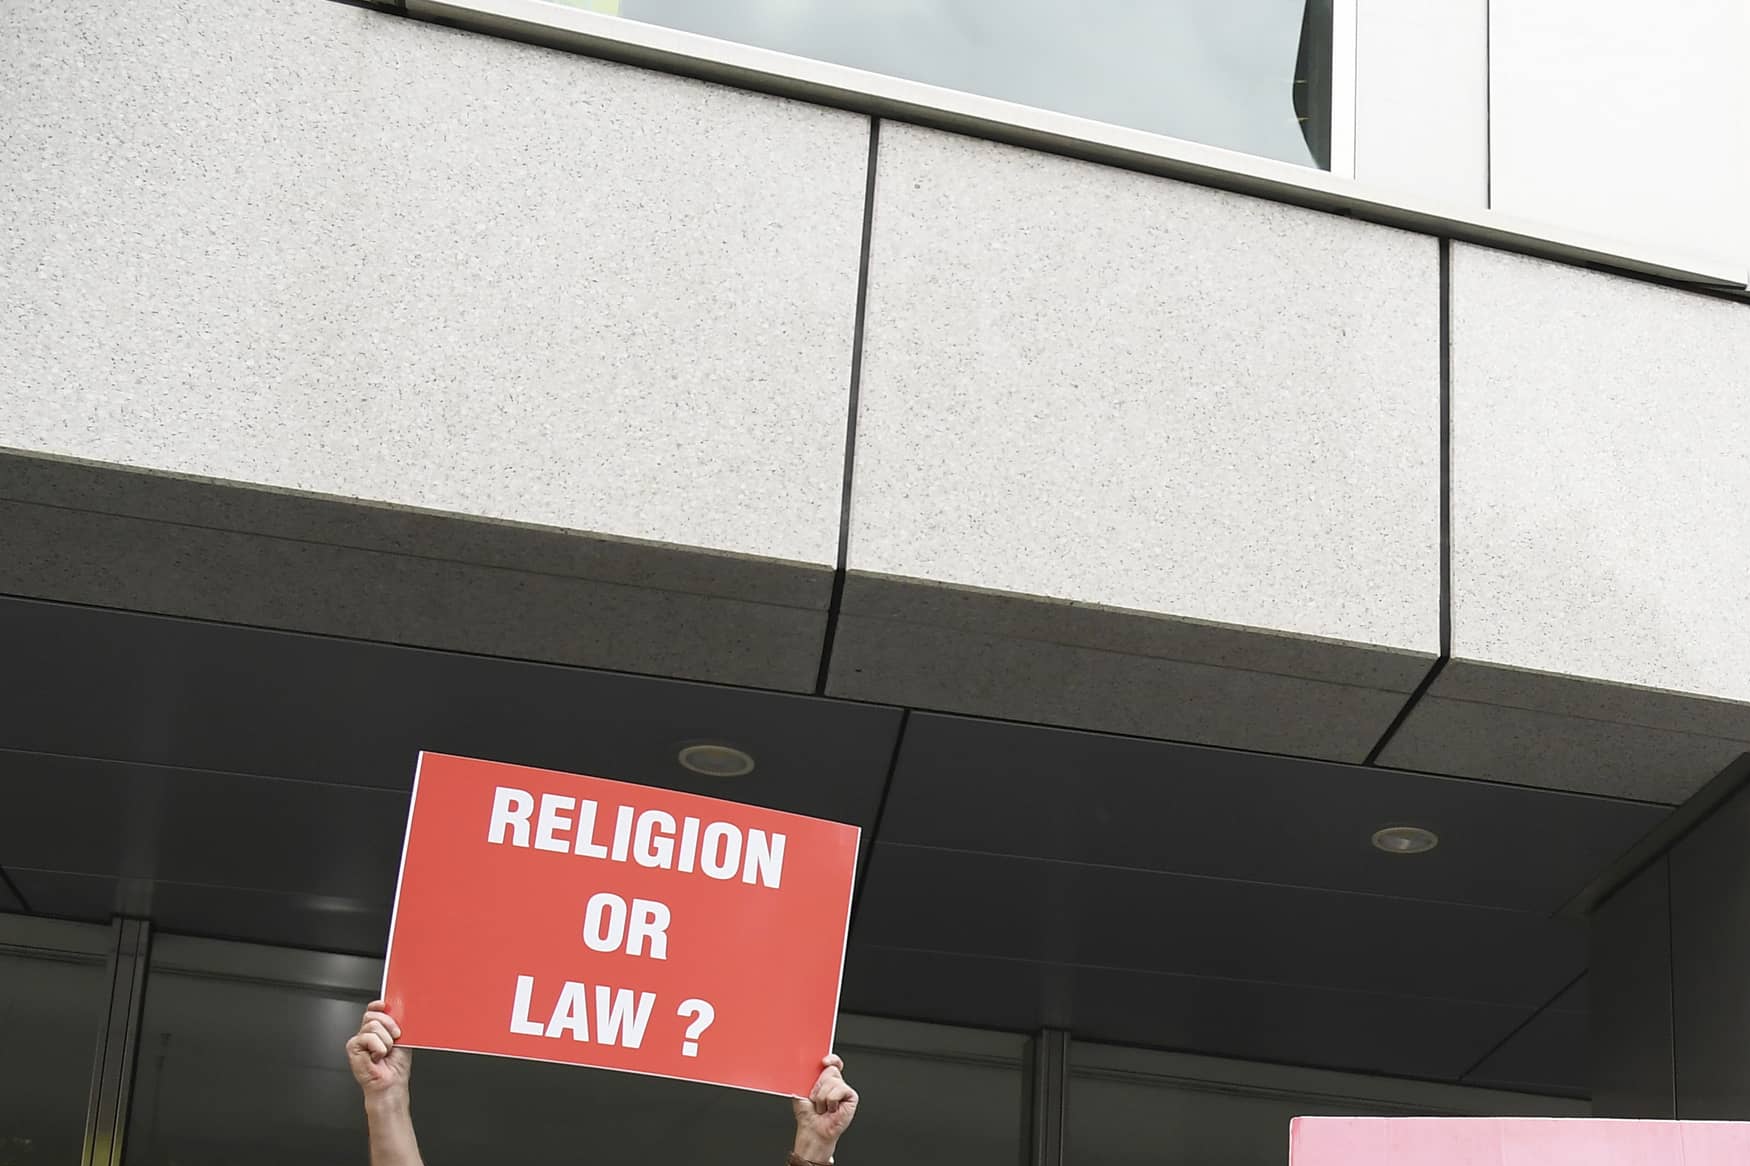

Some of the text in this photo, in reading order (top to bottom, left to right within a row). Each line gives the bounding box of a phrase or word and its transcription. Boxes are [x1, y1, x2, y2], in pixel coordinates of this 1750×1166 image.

[487, 786, 786, 889] RELIGION
[583, 892, 671, 960] OR
[509, 975, 714, 1057] LAW ?
